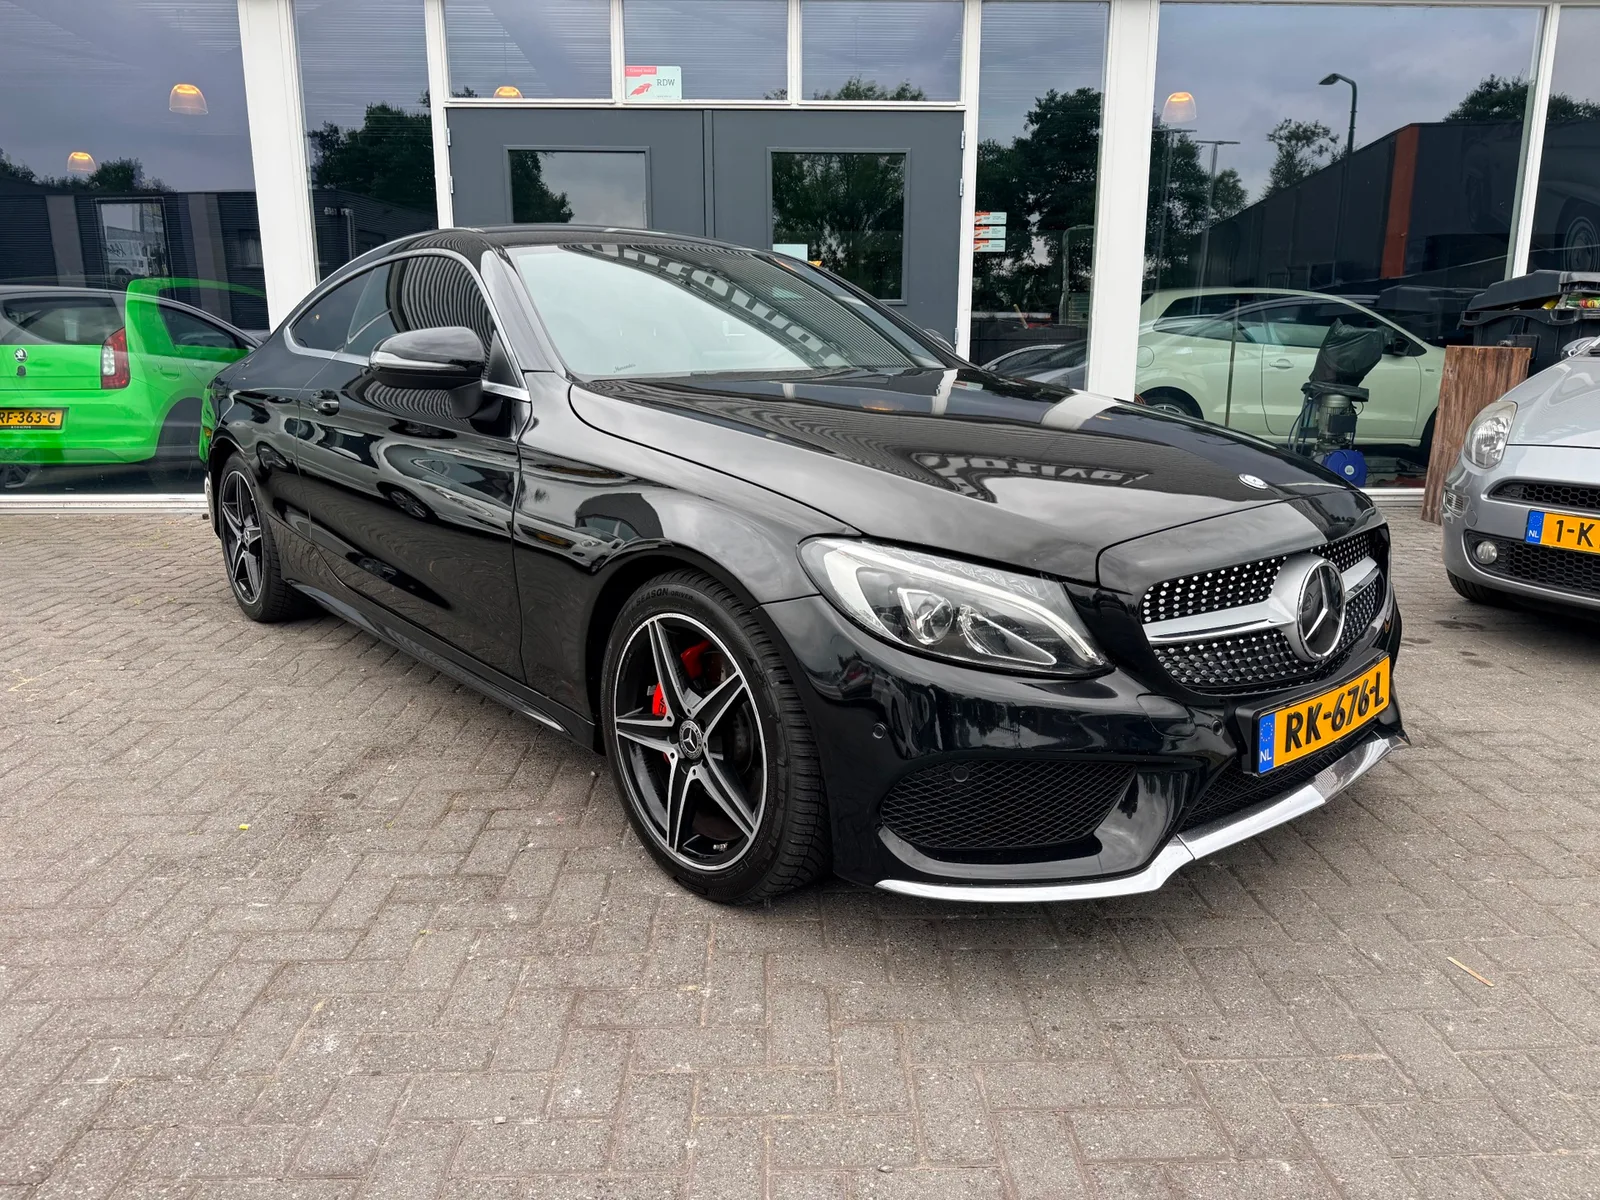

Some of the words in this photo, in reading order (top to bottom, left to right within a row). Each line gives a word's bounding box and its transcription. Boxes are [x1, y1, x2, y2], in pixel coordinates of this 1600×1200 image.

[656, 78, 676, 87] RDW
[0, 411, 56, 424] RF-363-G
[1528, 529, 1540, 539] NL
[1556, 519, 1596, 548] 1-K
[636, 587, 669, 607] SEASON
[670, 590, 694, 601] DRIVER
[1284, 671, 1385, 753] RK-676-L
[1259, 748, 1273, 764] NL
